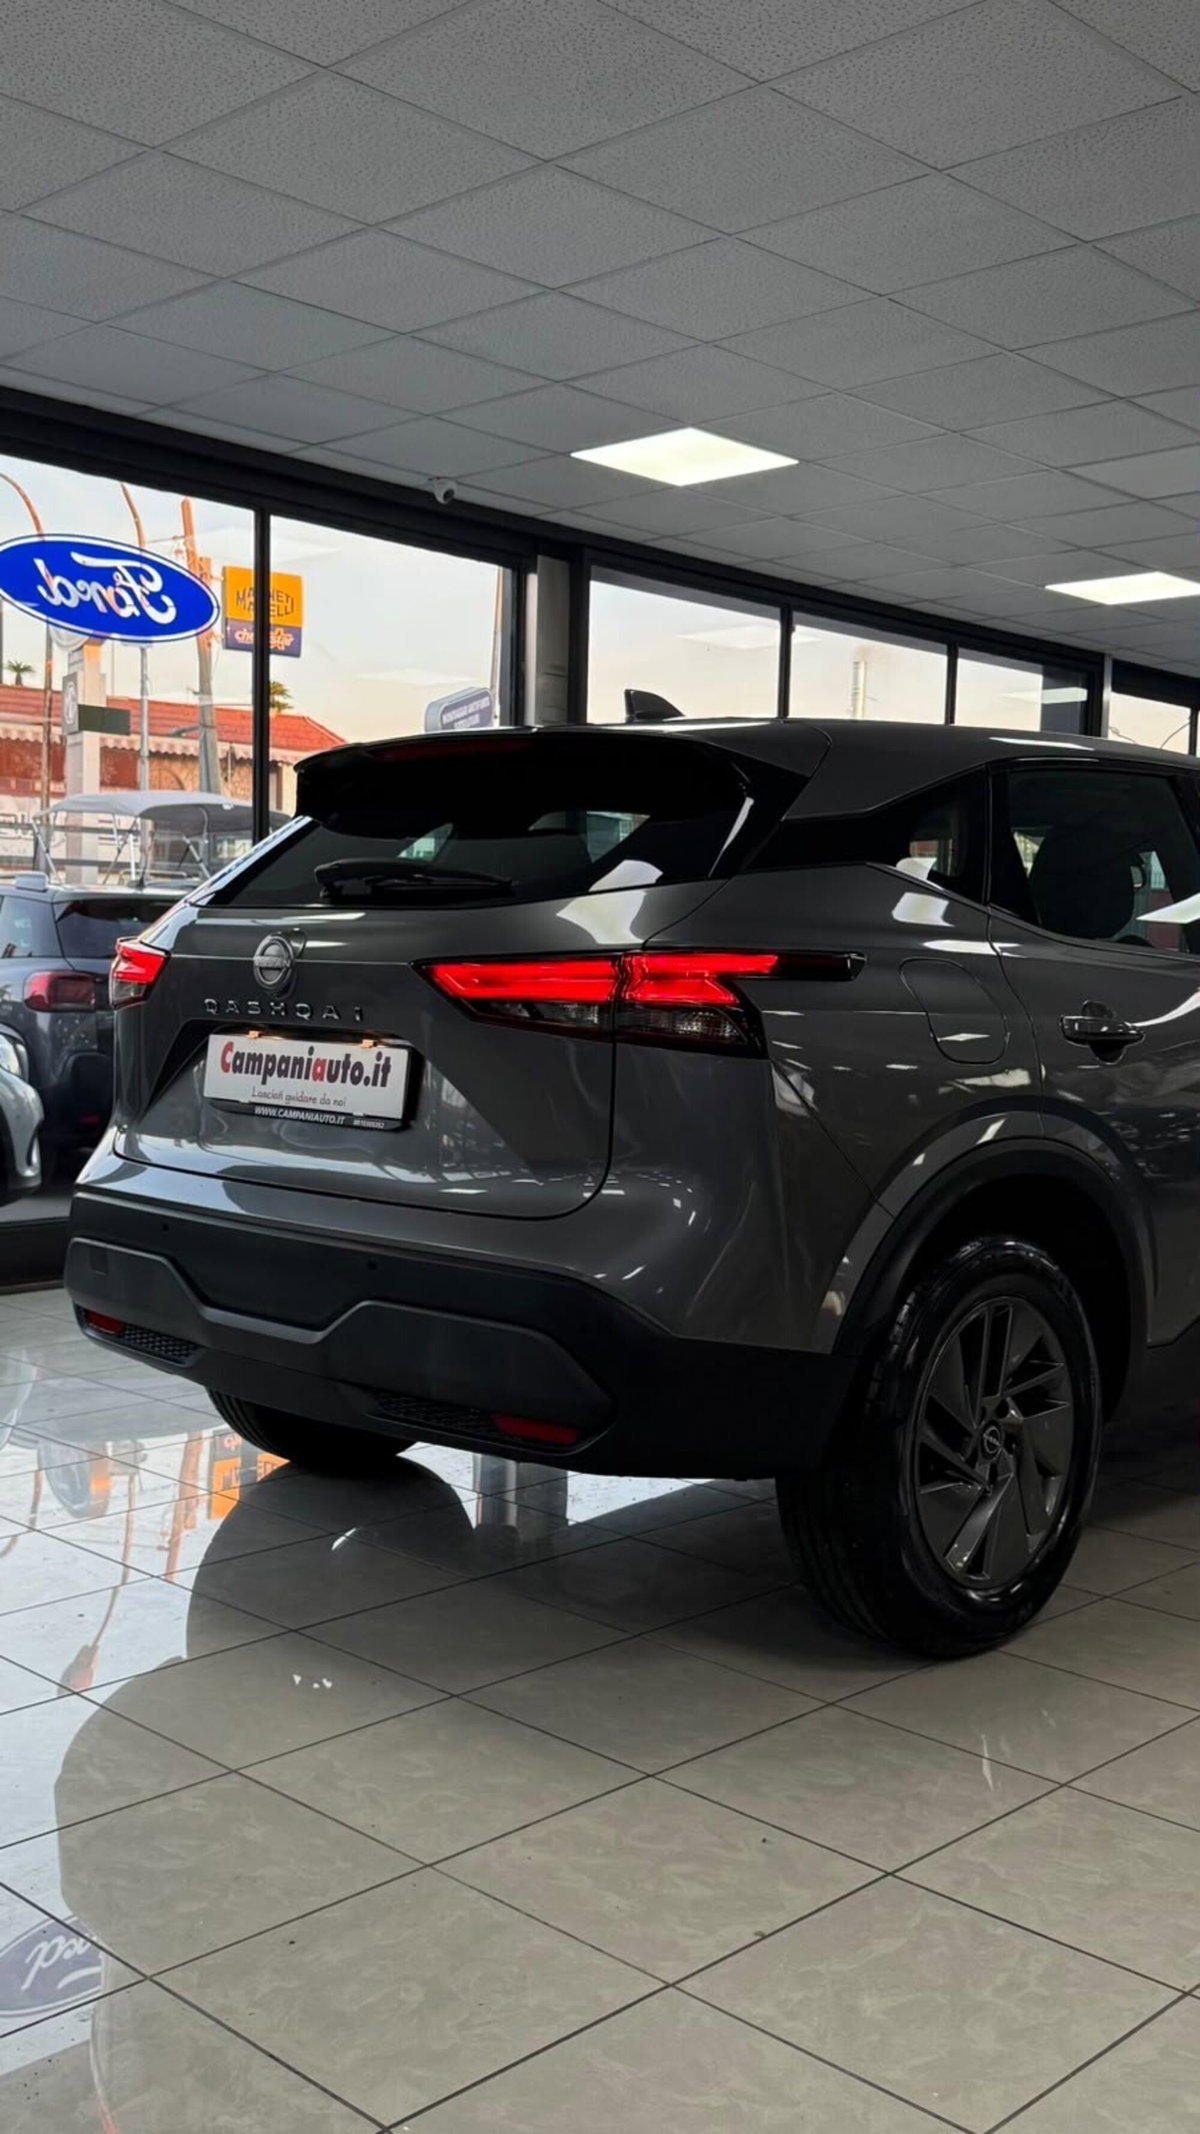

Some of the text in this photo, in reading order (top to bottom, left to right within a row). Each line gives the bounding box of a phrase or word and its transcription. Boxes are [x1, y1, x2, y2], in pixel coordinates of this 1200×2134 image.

[204, 998, 363, 1022] QASHQAI
[220, 1041, 392, 1088] Campaniauto.it
[285, 1087, 317, 1105] guidare
[319, 1092, 331, 1106] da
[332, 1096, 347, 1107] noi
[254, 1105, 346, 1125] WWW.CAMPANIAUTO.IT
